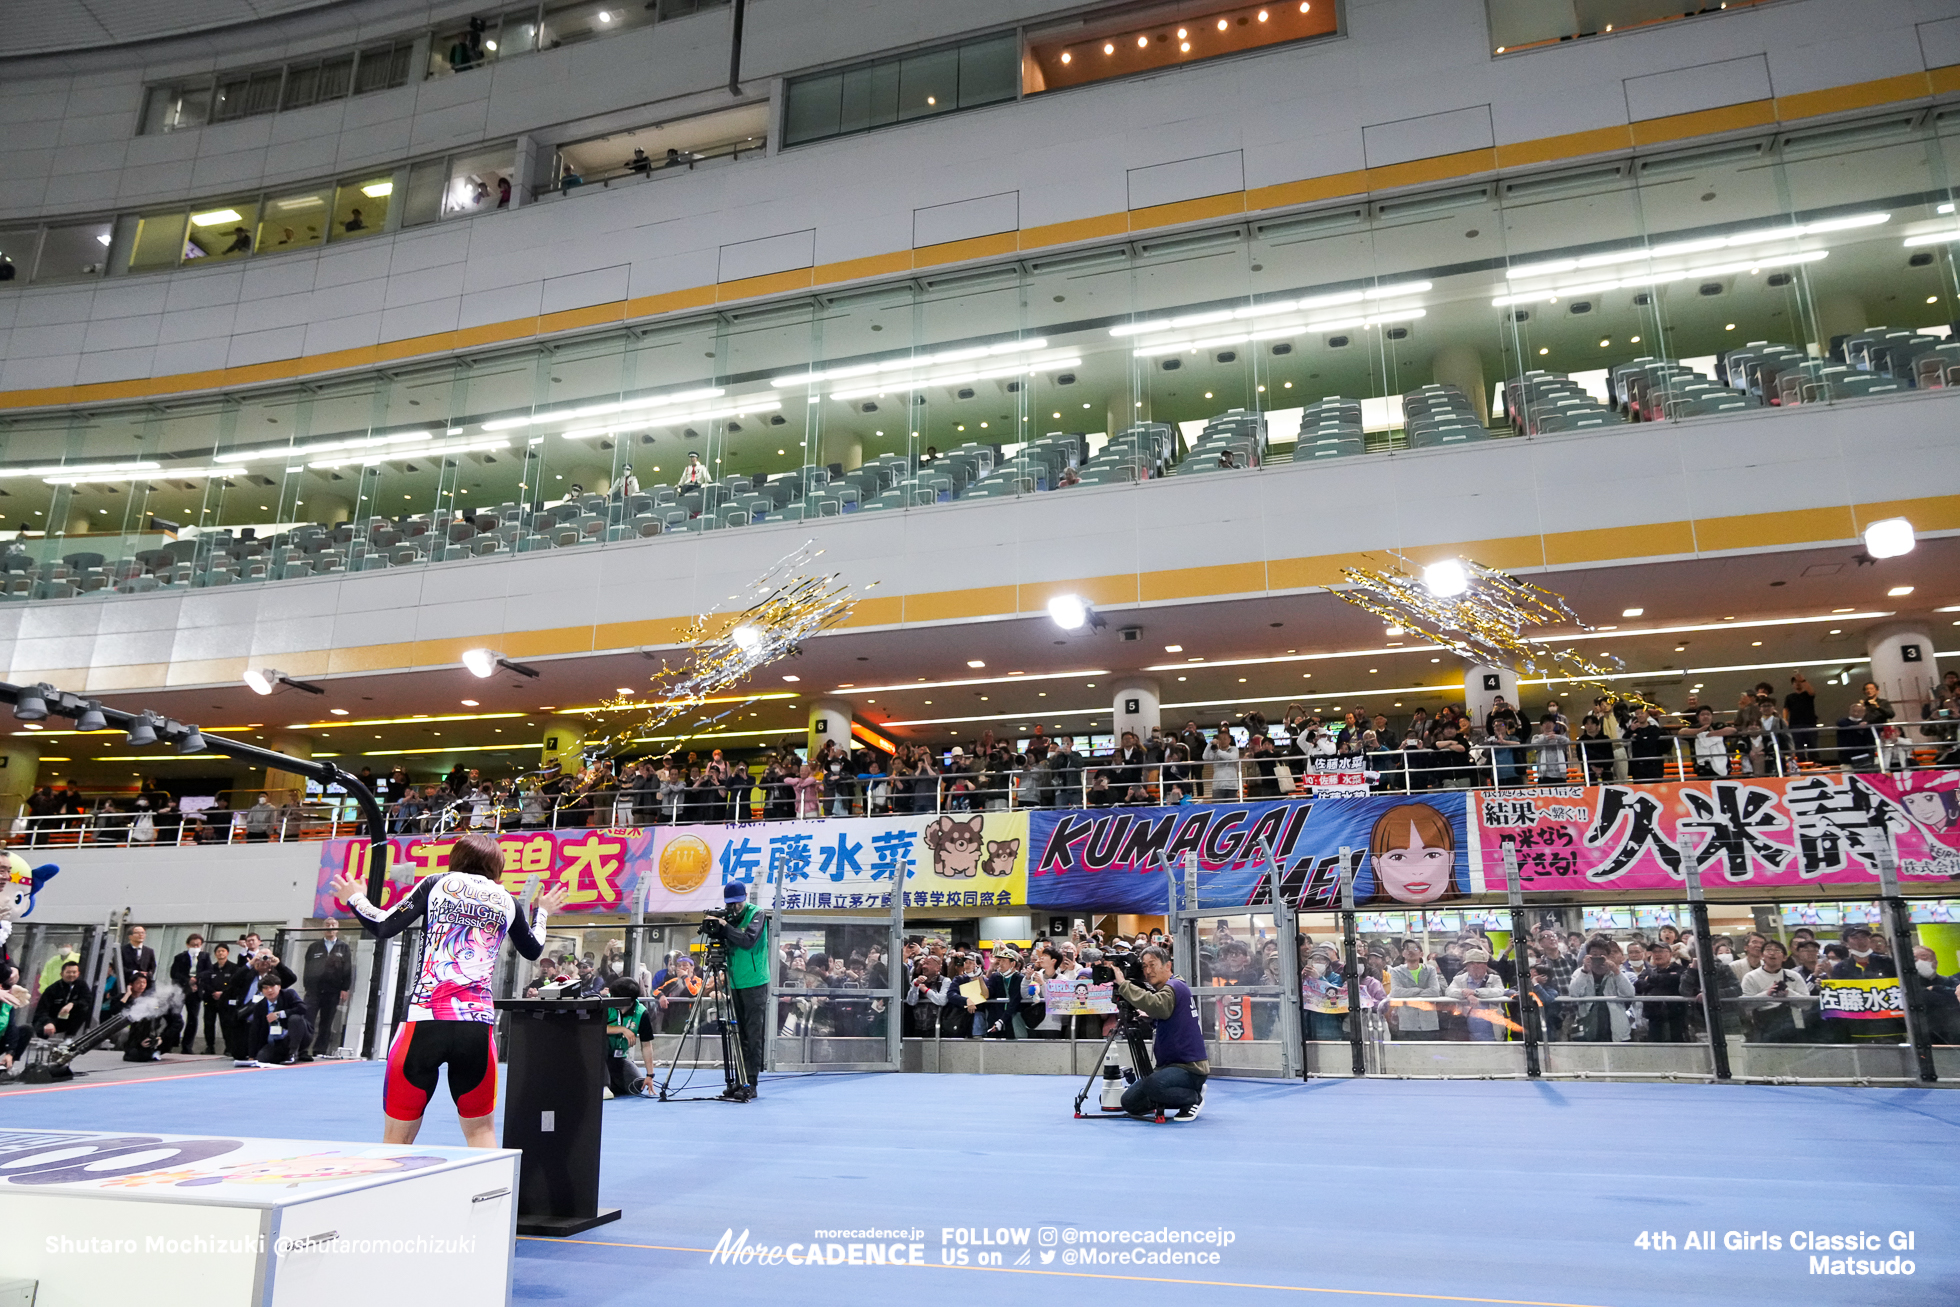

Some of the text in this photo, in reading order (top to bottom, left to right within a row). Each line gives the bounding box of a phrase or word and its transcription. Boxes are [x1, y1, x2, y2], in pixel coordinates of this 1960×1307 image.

[1907, 648, 1917, 658] 3
[1488, 677, 1496, 687] 4
[1128, 701, 1136, 711] 5
[818, 721, 824, 731] 6
[549, 739, 555, 748] 7
[1315, 755, 1364, 771] 佐藤水菜
[1585, 775, 1904, 879] 久米詩
[1036, 803, 1315, 875] KUMAGAI
[719, 829, 918, 886] 佐藤水菜
[1250, 847, 1369, 910] MEI
[442, 878, 511, 911] Queen
[446, 912, 486, 930] Classic
[1546, 910, 1557, 922] 4
[1054, 920, 1063, 932] 5
[652, 928, 660, 939] 6
[1820, 987, 1905, 1012] 佐藤水菜
